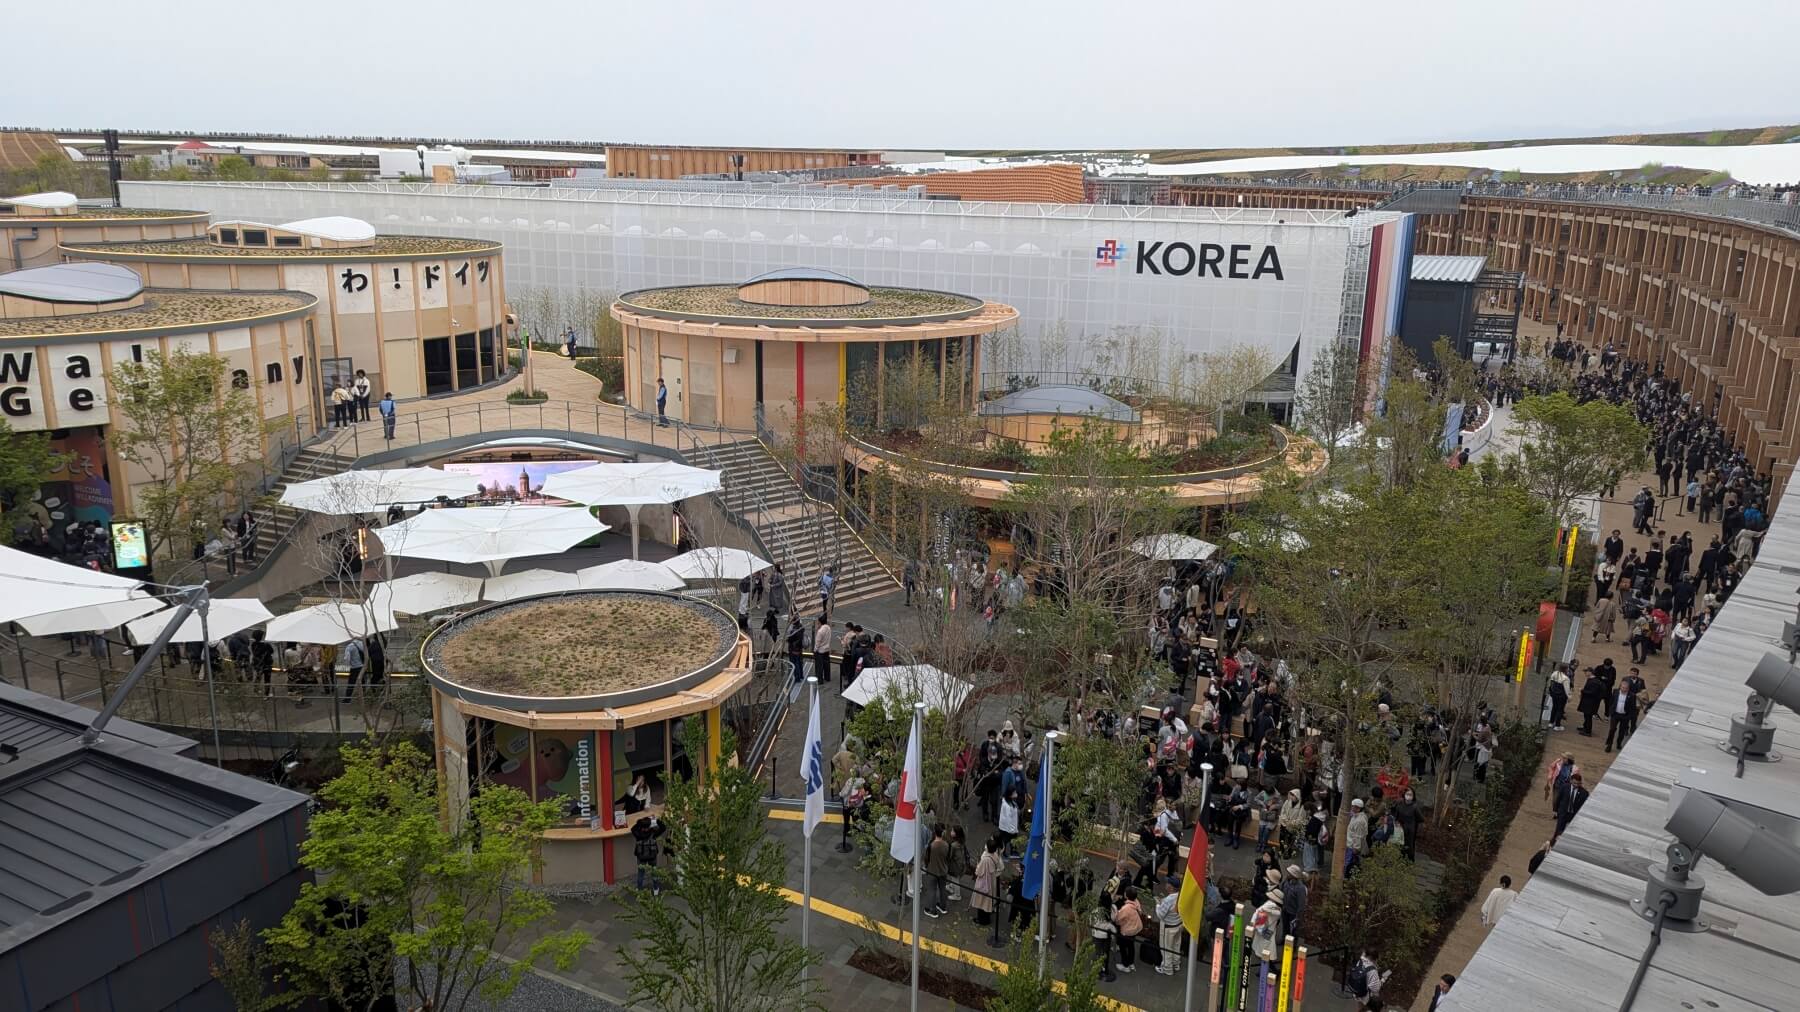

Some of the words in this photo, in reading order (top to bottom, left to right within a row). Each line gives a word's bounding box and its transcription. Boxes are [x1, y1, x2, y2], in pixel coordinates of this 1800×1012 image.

[341, 260, 489, 293] わ!ドイツ
[1136, 241, 1284, 280] KOREA
[575, 739, 591, 821] Information
